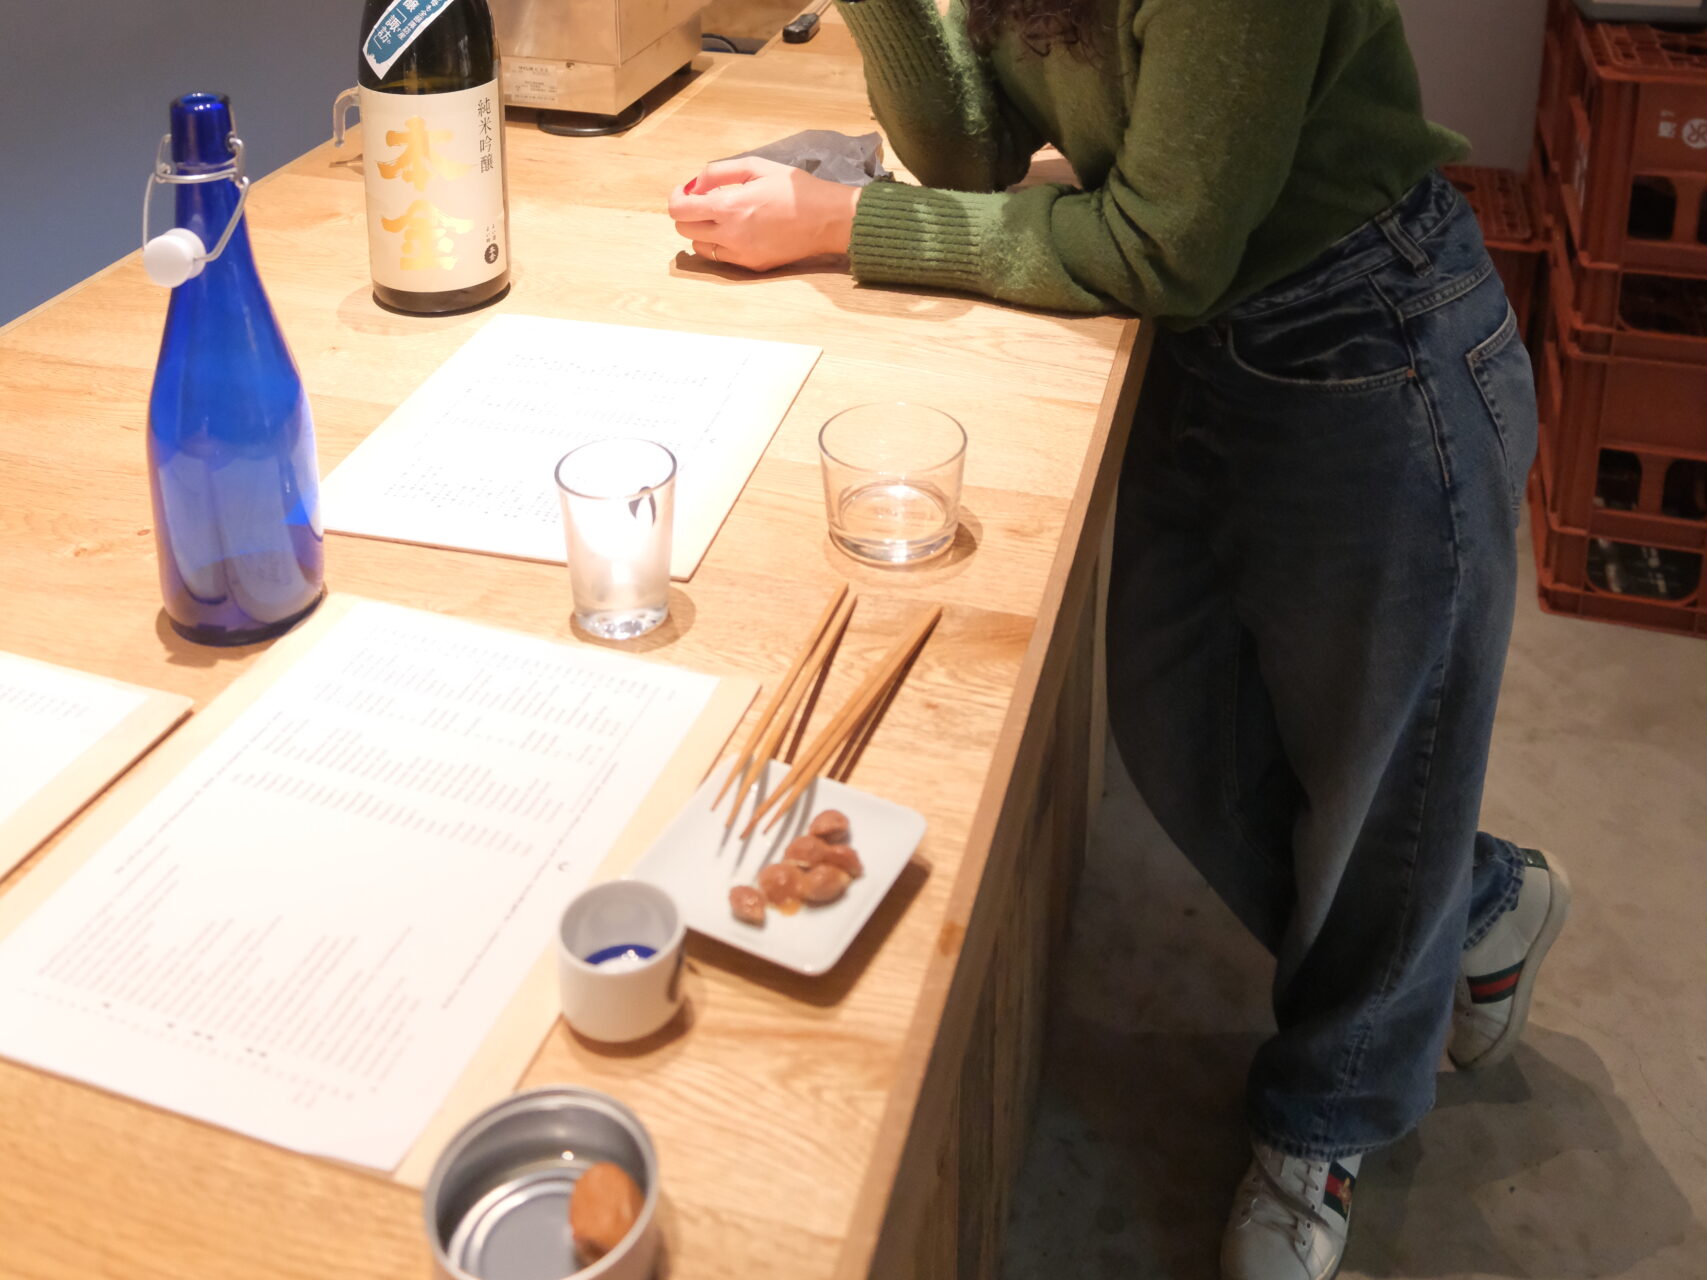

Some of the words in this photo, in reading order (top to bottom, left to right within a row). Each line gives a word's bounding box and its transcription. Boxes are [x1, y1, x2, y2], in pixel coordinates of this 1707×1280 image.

[376, 115, 474, 271] 本金
[477, 97, 494, 174] 純米吟醸
